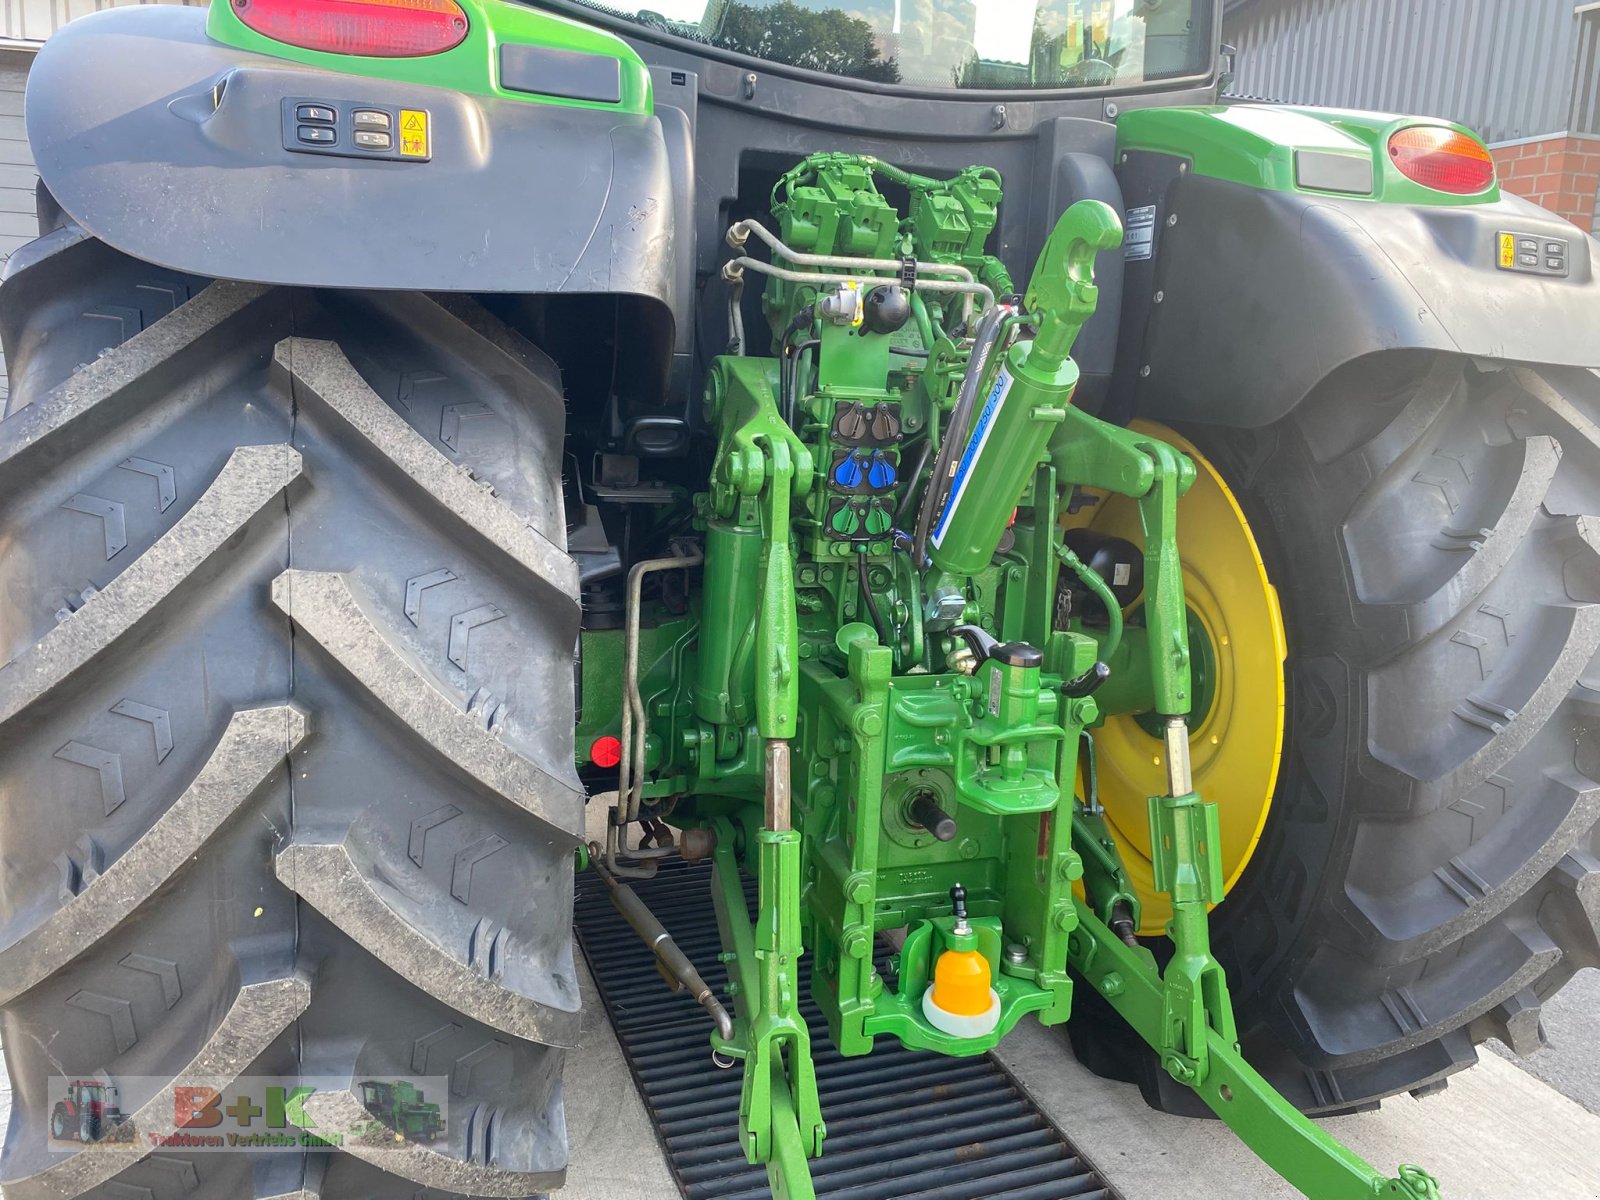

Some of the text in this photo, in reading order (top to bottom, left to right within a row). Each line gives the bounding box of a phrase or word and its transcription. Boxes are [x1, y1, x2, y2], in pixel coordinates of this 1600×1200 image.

[967, 433, 978, 459] 200
[979, 405, 991, 432] 250
[992, 375, 1004, 403] 300
